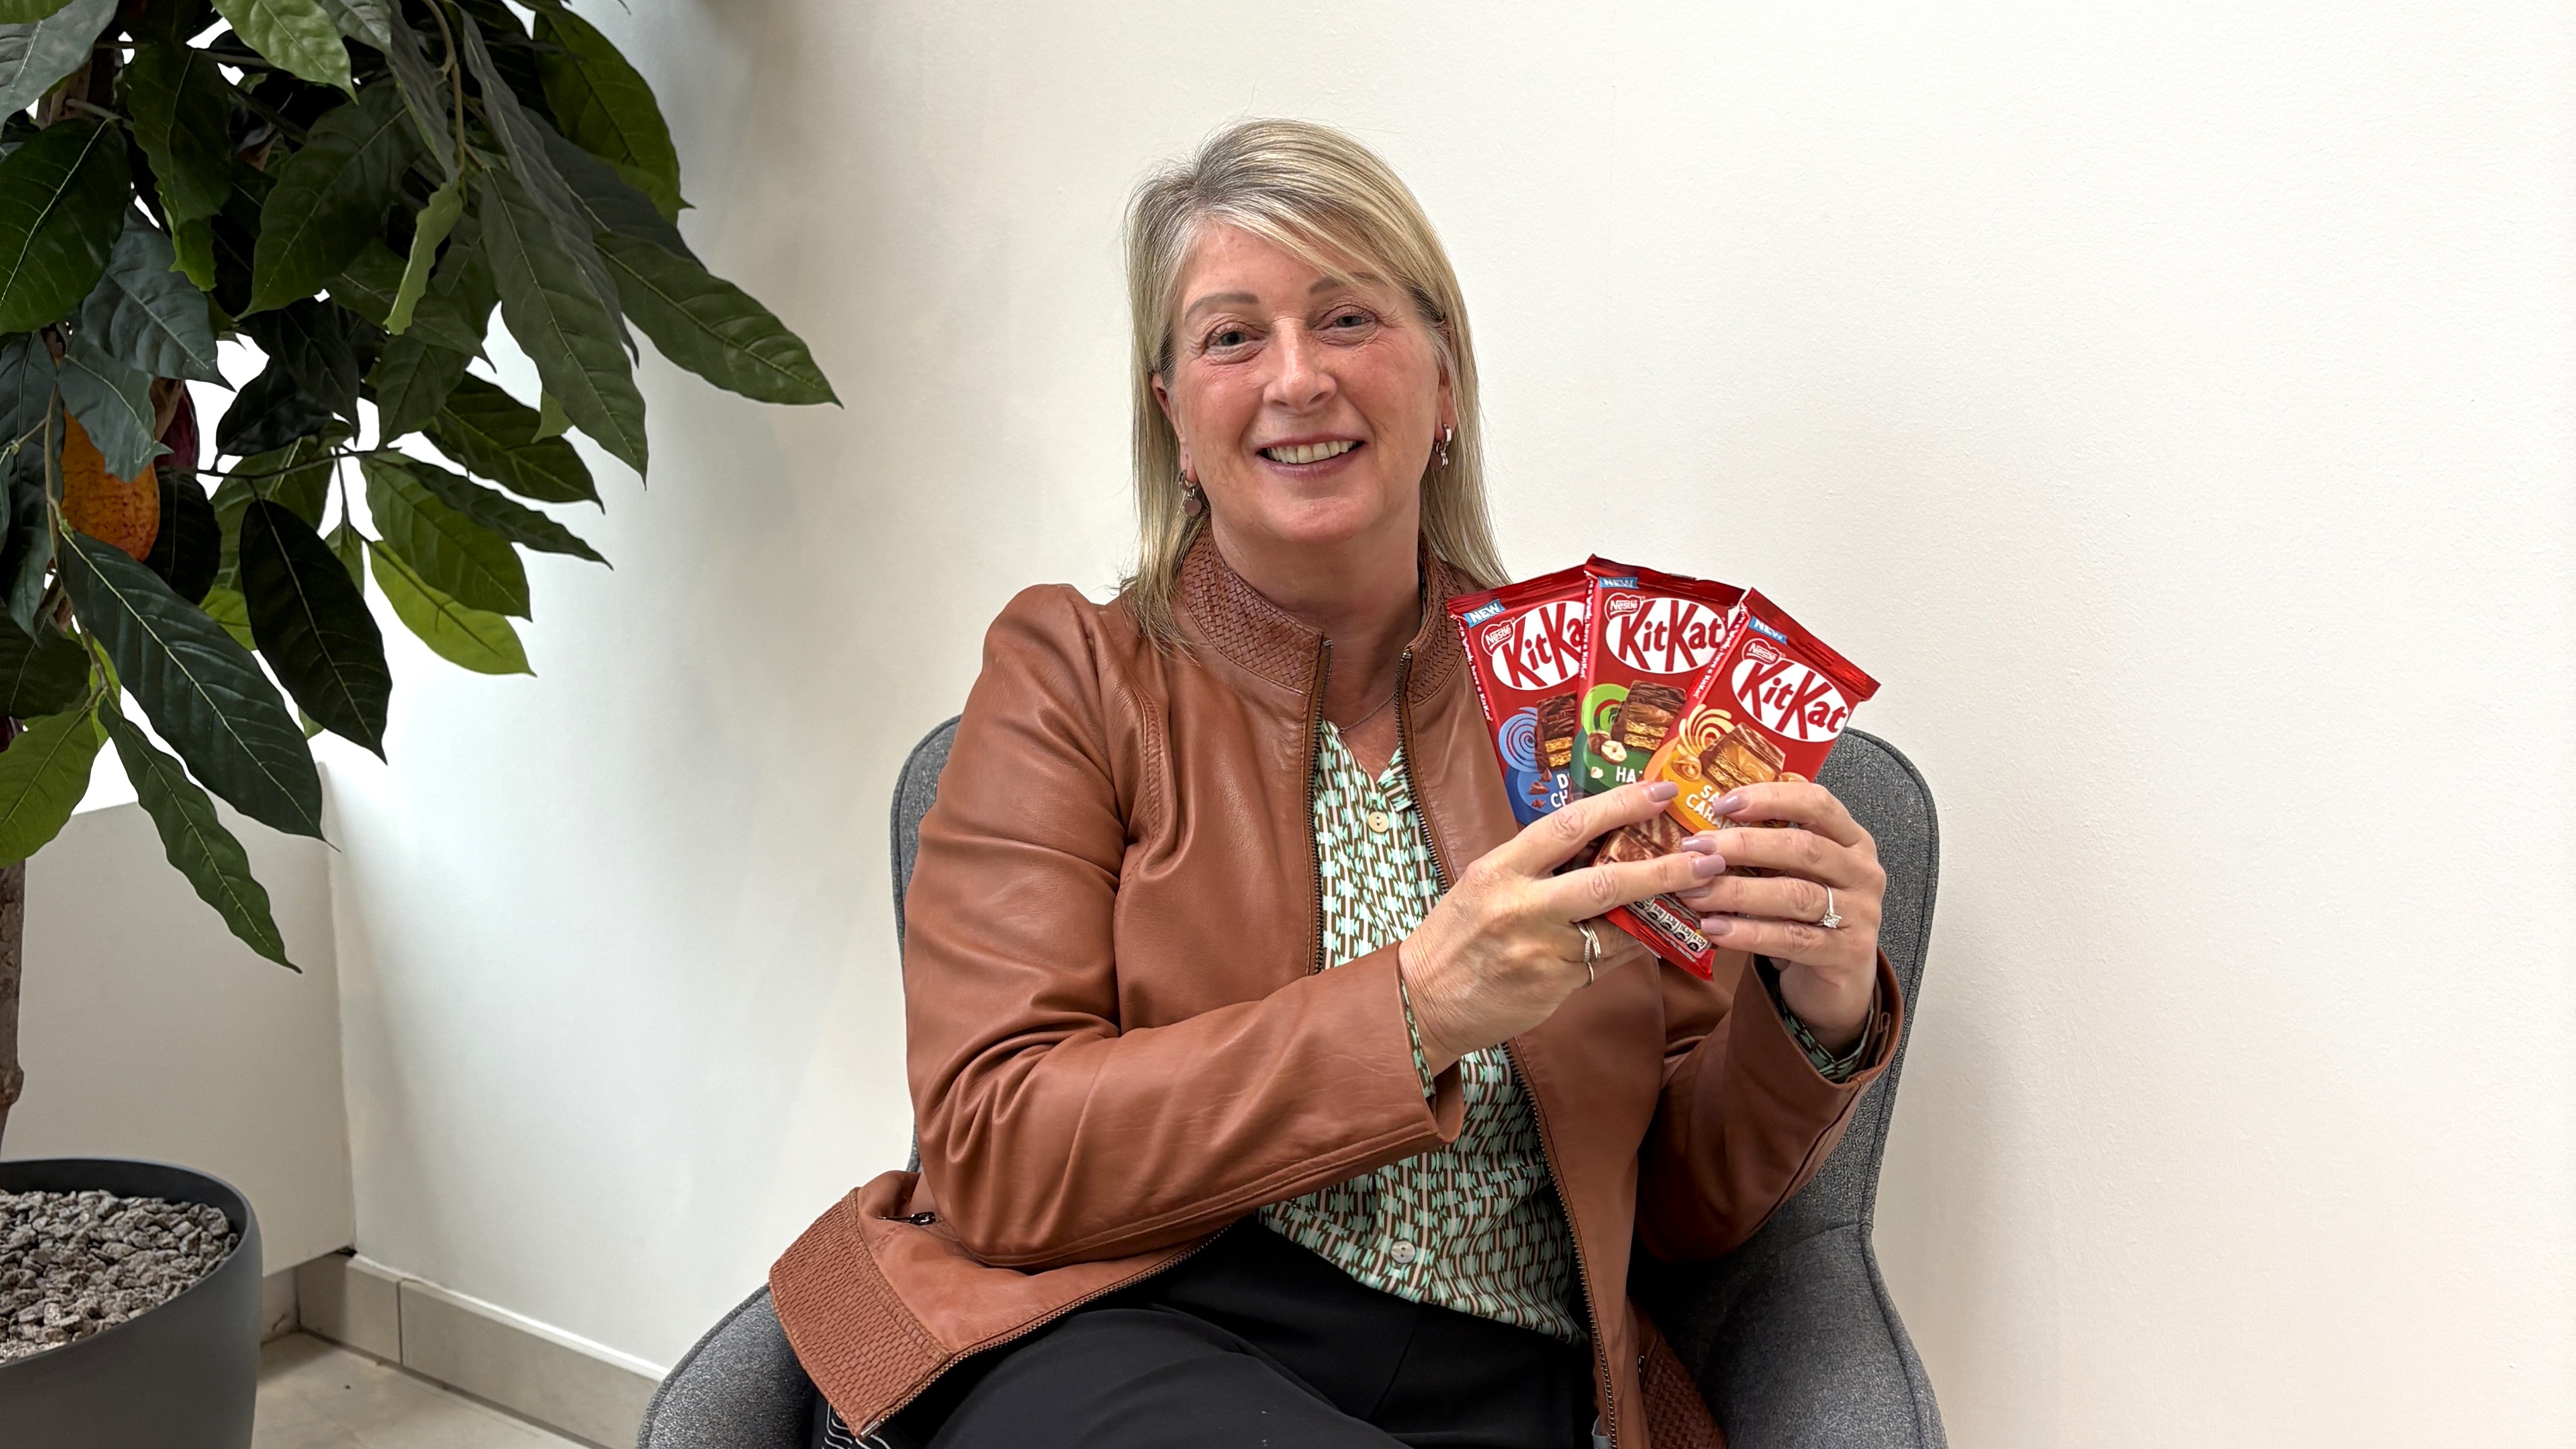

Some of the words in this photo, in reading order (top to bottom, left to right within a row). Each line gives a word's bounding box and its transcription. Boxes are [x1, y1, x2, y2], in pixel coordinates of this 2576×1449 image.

[1470, 603, 1500, 623] NEW
[1501, 602, 1583, 688] KitKa
[1618, 600, 1722, 672] KitKat
[1754, 618, 1783, 640] NEW
[1737, 660, 1847, 740] KitKat
